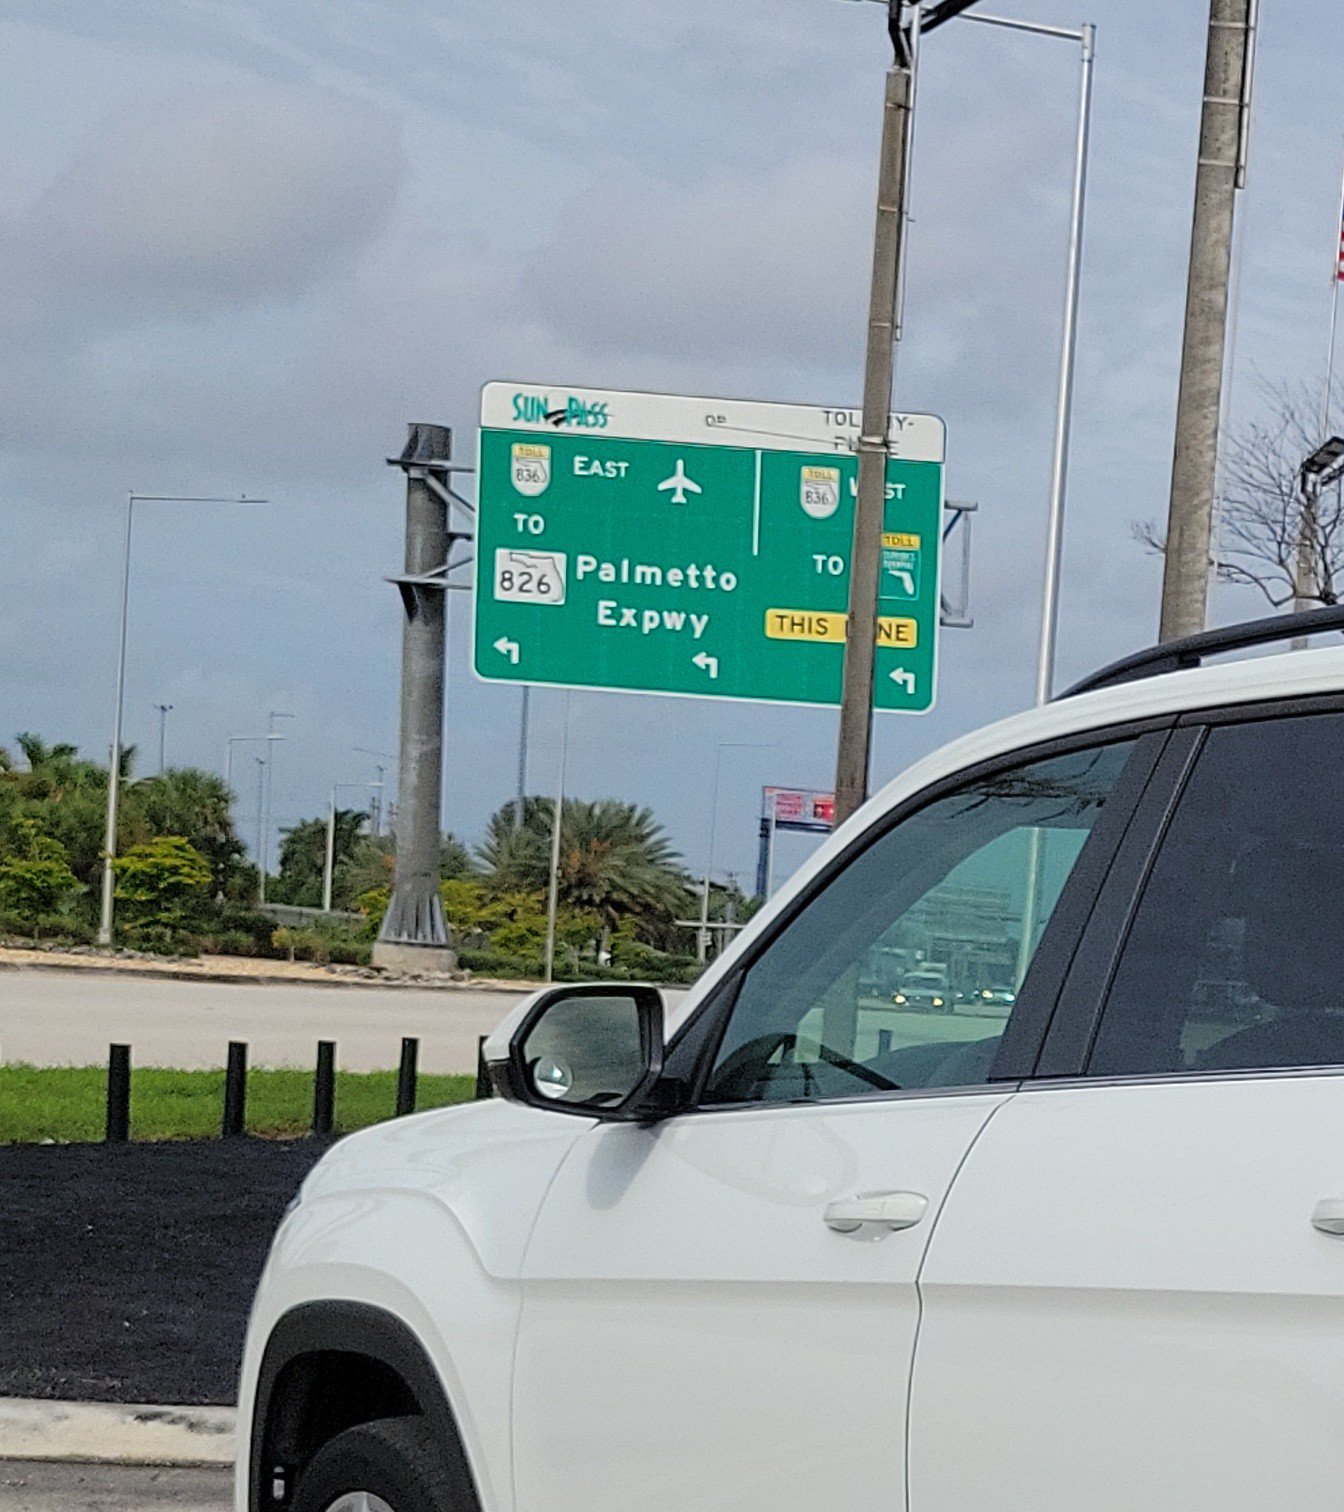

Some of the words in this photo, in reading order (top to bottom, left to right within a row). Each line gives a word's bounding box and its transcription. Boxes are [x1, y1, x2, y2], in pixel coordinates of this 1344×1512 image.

[823, 410, 914, 431] TOLY-
[516, 468, 541, 483] 836
[573, 455, 629, 478] EAST
[513, 513, 545, 534] TO
[576, 554, 738, 591] Palmetto
[812, 554, 844, 576] TO
[500, 569, 551, 595] 826
[597, 600, 709, 639] Expwy
[775, 614, 829, 636] THIS
[846, 620, 909, 642] NE
